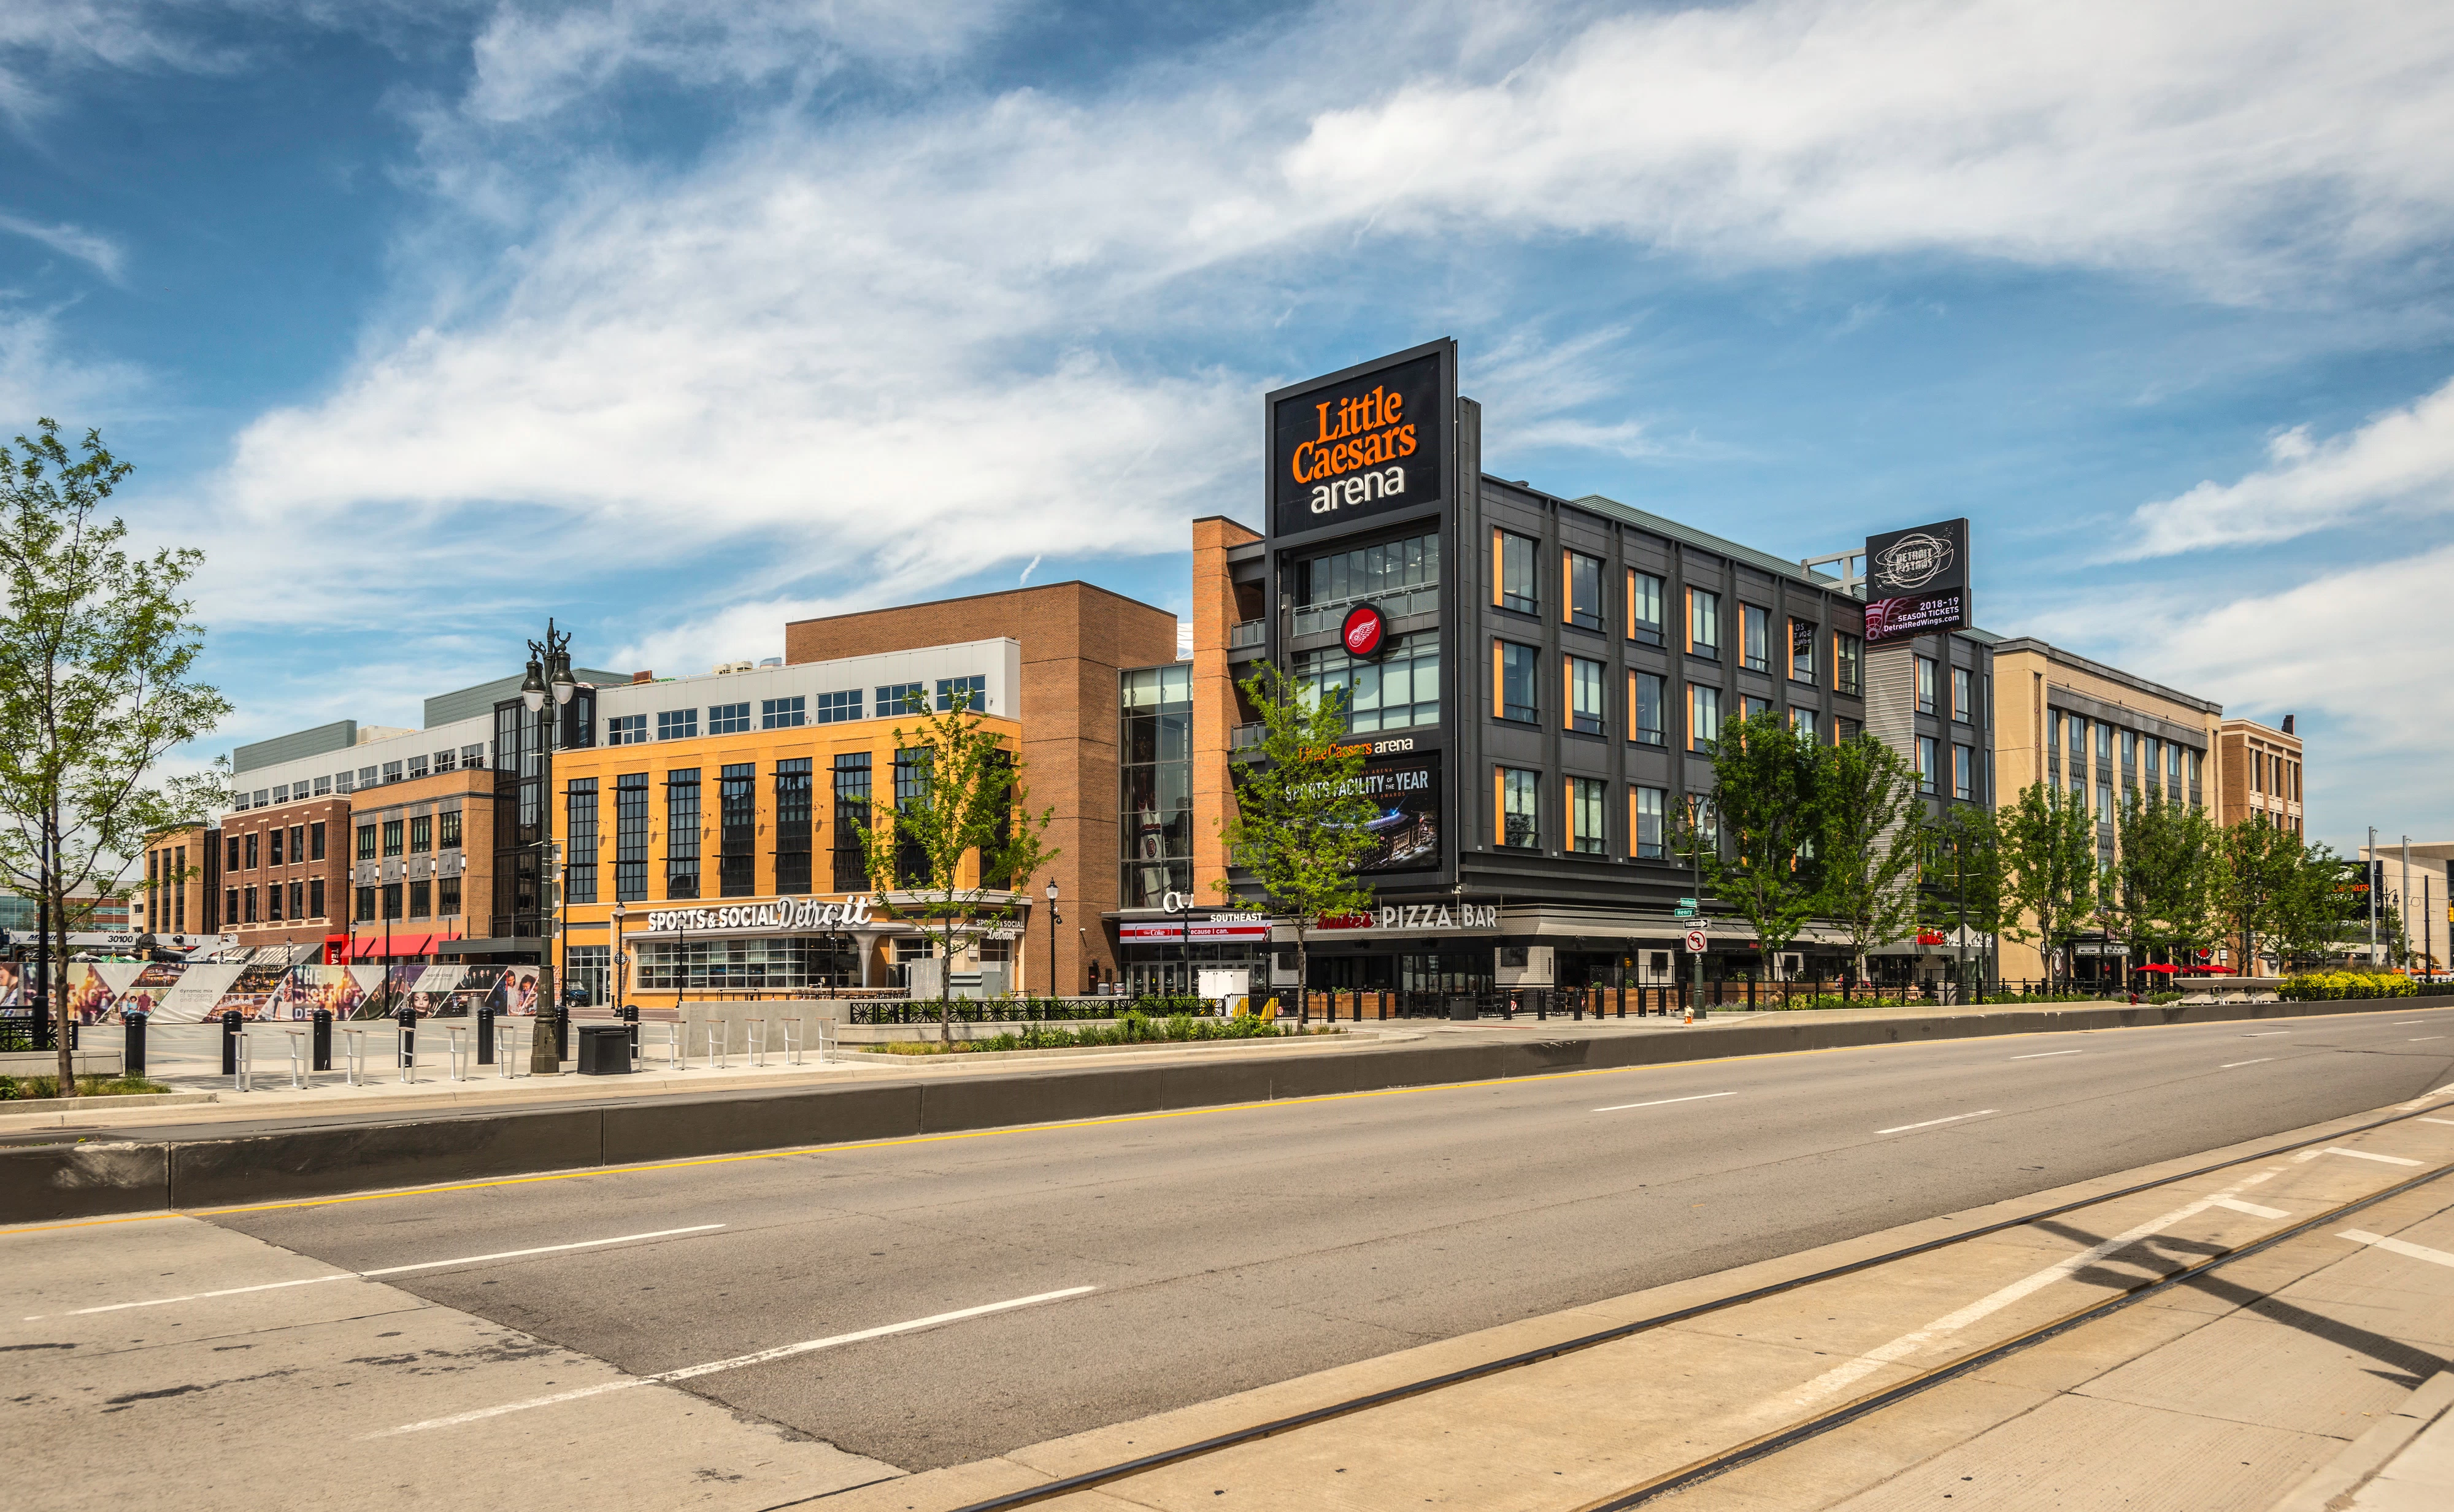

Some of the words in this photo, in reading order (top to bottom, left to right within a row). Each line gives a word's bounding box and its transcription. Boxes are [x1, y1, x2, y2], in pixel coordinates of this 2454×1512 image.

[1316, 385, 1402, 444] Little
[1293, 424, 1417, 483] Caesars
[1311, 466, 1405, 513] arena
[1896, 548, 1932, 562] DETROIT
[1896, 558, 1933, 574] PISTONS
[1920, 597, 1959, 610] 2018-19
[1898, 612, 1926, 621] SEASON
[1928, 606, 1959, 616] TICKETS
[1884, 615, 1960, 632] DetroitRedWings.com
[1299, 747, 1326, 762] Lie
[1374, 738, 1413, 754] arena
[1396, 770, 1428, 791] YEAR
[2332, 883, 2369, 892] aars
[707, 912, 717, 928] &
[718, 905, 779, 927] SOCIAL
[776, 895, 872, 928] Detroit
[1210, 913, 1263, 922] SOUTHEAST
[1383, 904, 1453, 928] PIZZA
[1462, 904, 1496, 927] BAR
[987, 928, 1016, 940] Detroit
[248, 946, 303, 964] STORE
[295, 969, 321, 984] THE
[25, 989, 108, 1007] DSRICT
[295, 988, 360, 1004] DISTRICT
